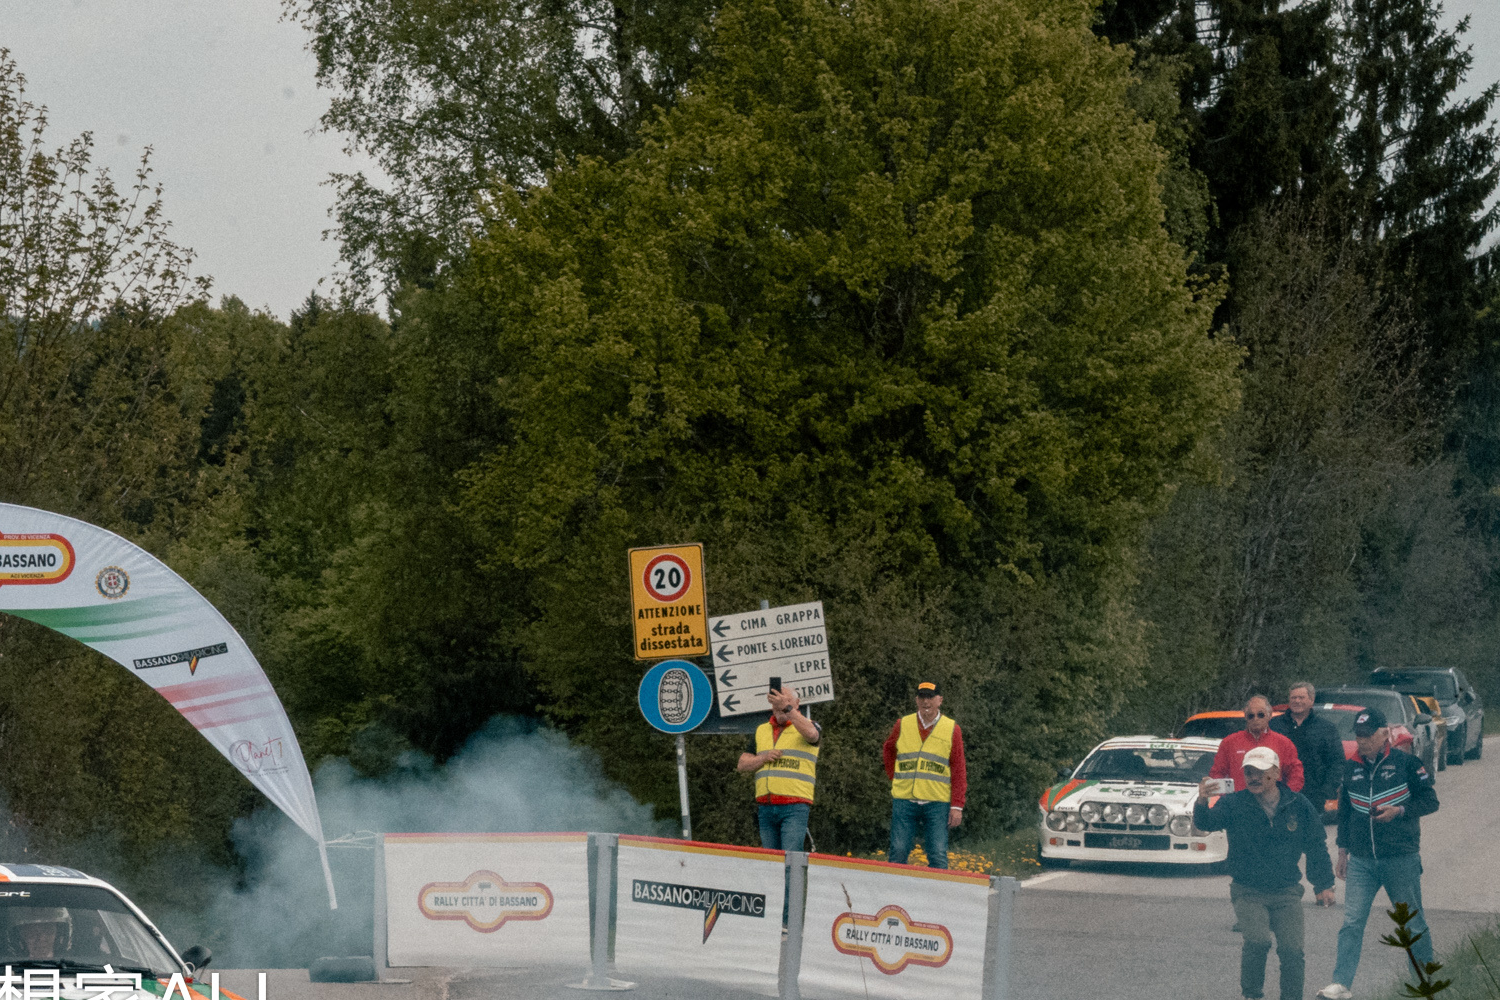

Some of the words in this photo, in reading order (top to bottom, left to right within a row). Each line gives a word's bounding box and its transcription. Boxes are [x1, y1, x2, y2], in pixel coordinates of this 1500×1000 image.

[654, 567, 681, 590] 20
[638, 604, 702, 620] ATTENZIONE
[740, 617, 767, 631] CIMA
[776, 608, 821, 625] GRAPPA
[651, 621, 690, 637] strada
[640, 635, 704, 652] dissestata
[737, 642, 768, 657] PONTE
[794, 658, 827, 674] LEPRE
[434, 896, 458, 907] RALLY
[489, 896, 497, 907] DI
[499, 896, 538, 907] BASSANO
[845, 928, 870, 941] RALLY
[894, 935, 903, 947] DI
[904, 936, 940, 952] BASSANO
